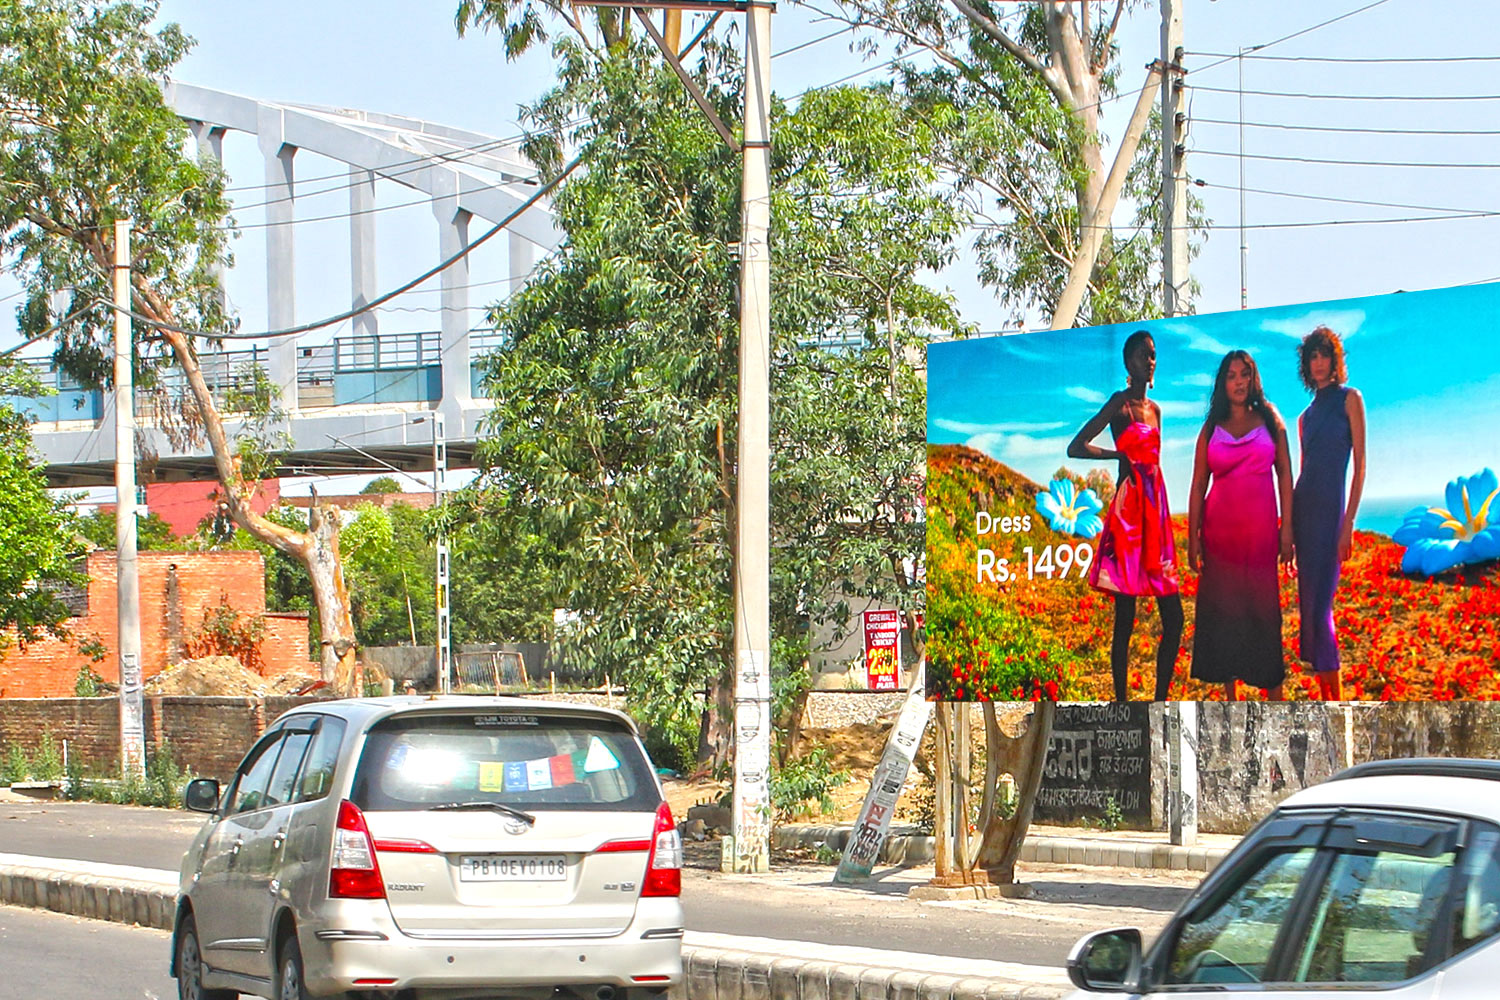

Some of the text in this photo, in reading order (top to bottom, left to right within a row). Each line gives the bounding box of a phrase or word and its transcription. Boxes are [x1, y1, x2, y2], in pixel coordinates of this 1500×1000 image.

[976, 511, 1032, 535] Dress
[977, 543, 1094, 583] Rs. 1499
